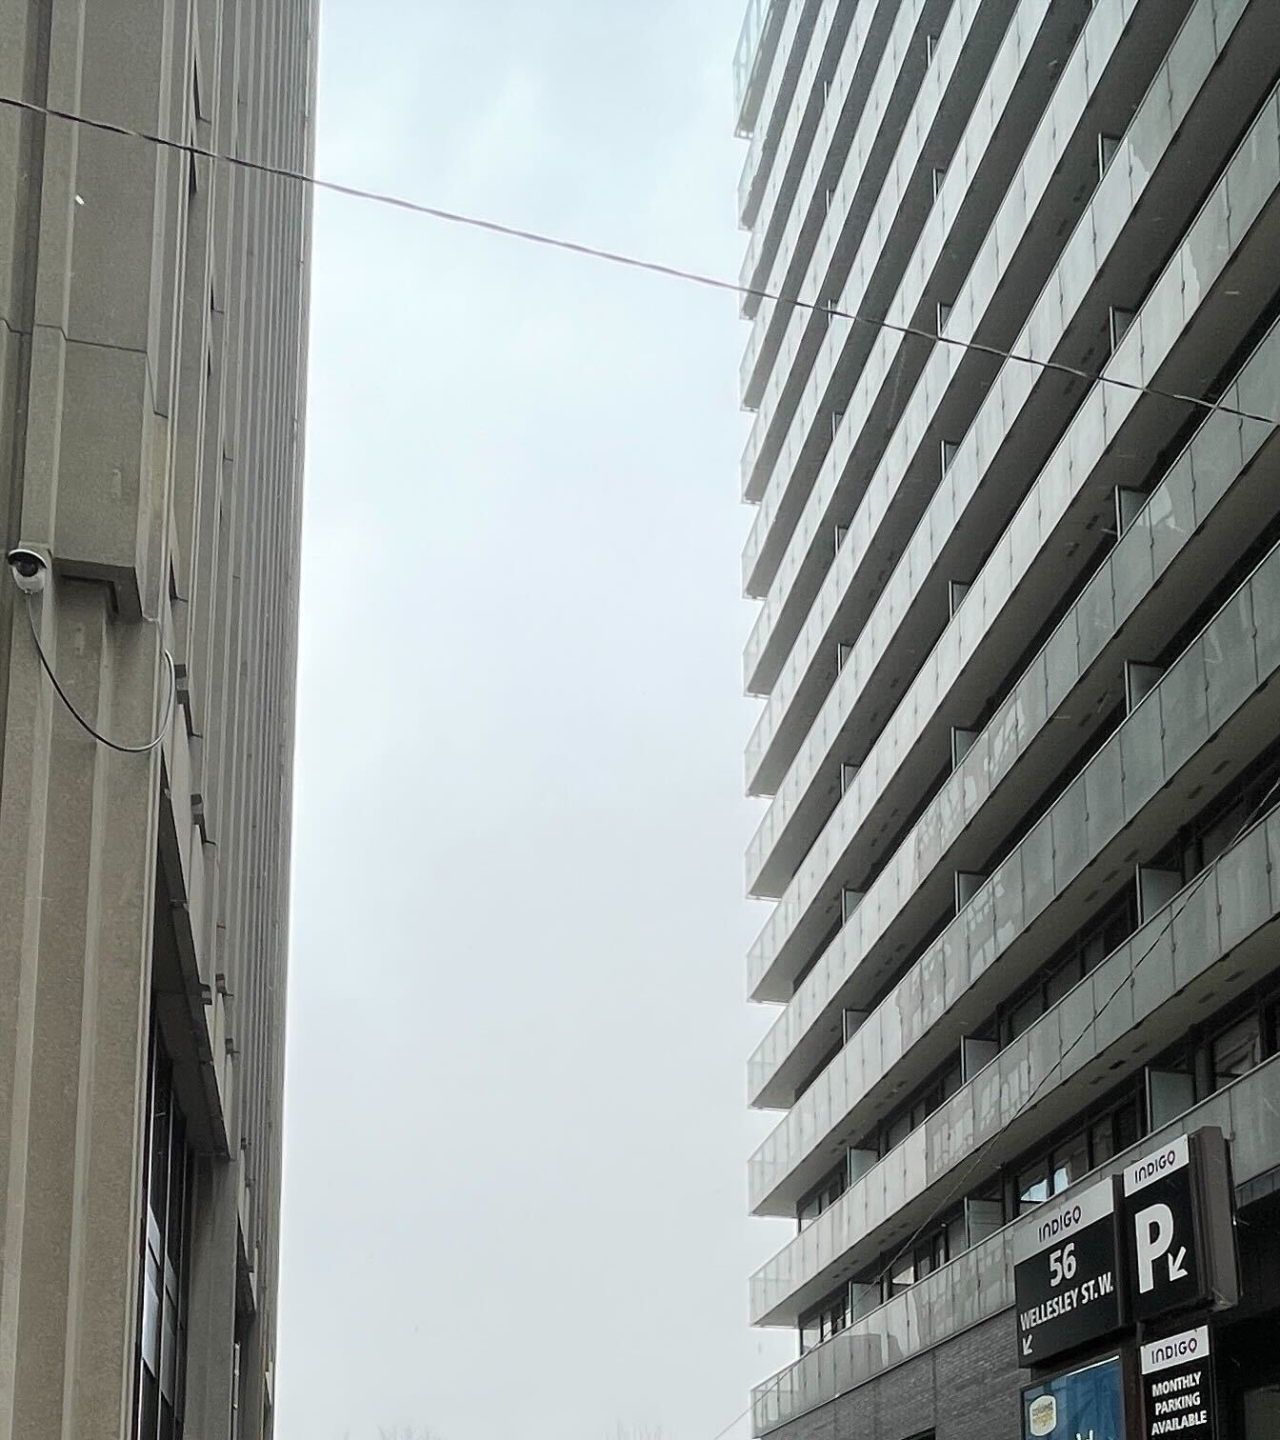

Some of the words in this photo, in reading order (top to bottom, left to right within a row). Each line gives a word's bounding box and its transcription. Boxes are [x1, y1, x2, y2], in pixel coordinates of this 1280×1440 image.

[1135, 1150, 1176, 1184] INDIGO
[1038, 1205, 1082, 1243] INDIGO
[1049, 1243, 1077, 1287] 56
[1135, 1203, 1174, 1294] P
[1020, 1287, 1078, 1331] WELLESLEY
[1152, 1338, 1198, 1364] INDIGO
[1152, 1371, 1201, 1397] MONTHLY
[1155, 1392, 1200, 1416] PARKING
[1152, 1410, 1207, 1436] AVAILABLE
